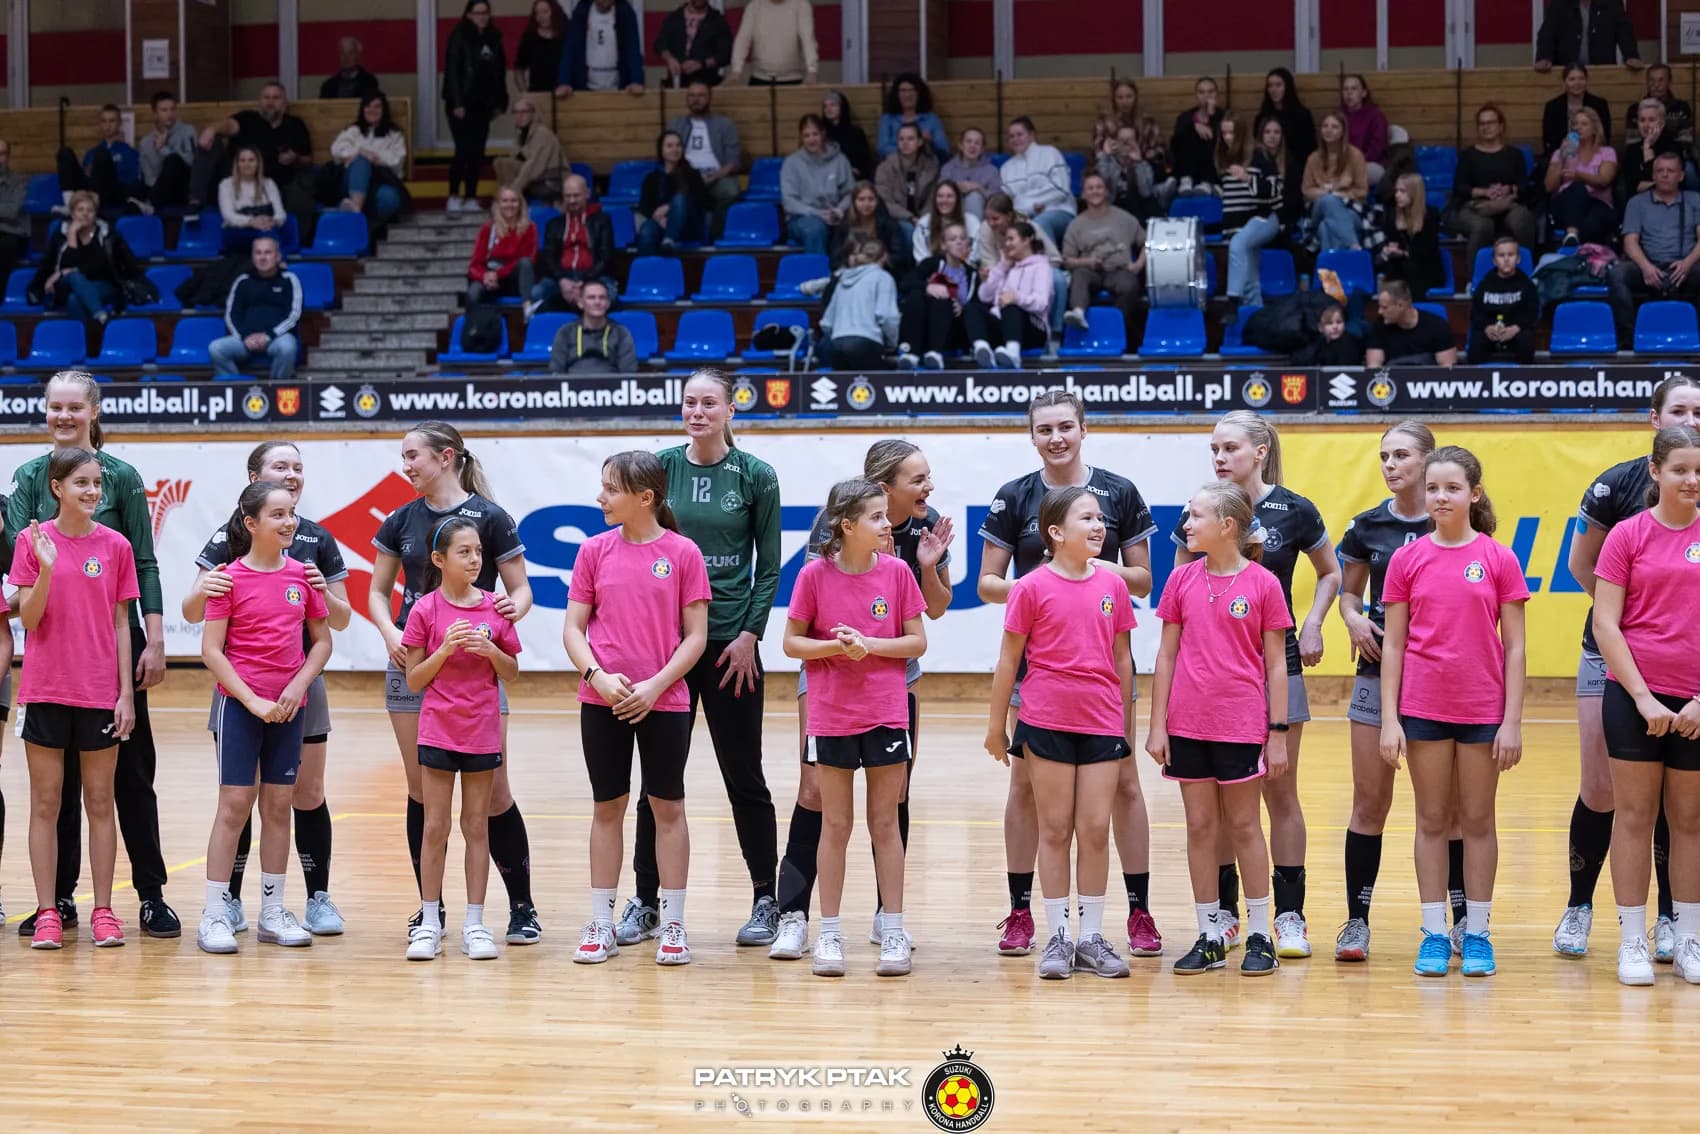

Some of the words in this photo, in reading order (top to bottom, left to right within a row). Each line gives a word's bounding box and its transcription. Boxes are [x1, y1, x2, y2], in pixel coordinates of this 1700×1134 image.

[691, 476, 711, 503] 12
[1261, 500, 1288, 511] Joma
[703, 554, 740, 567] ZUKI
